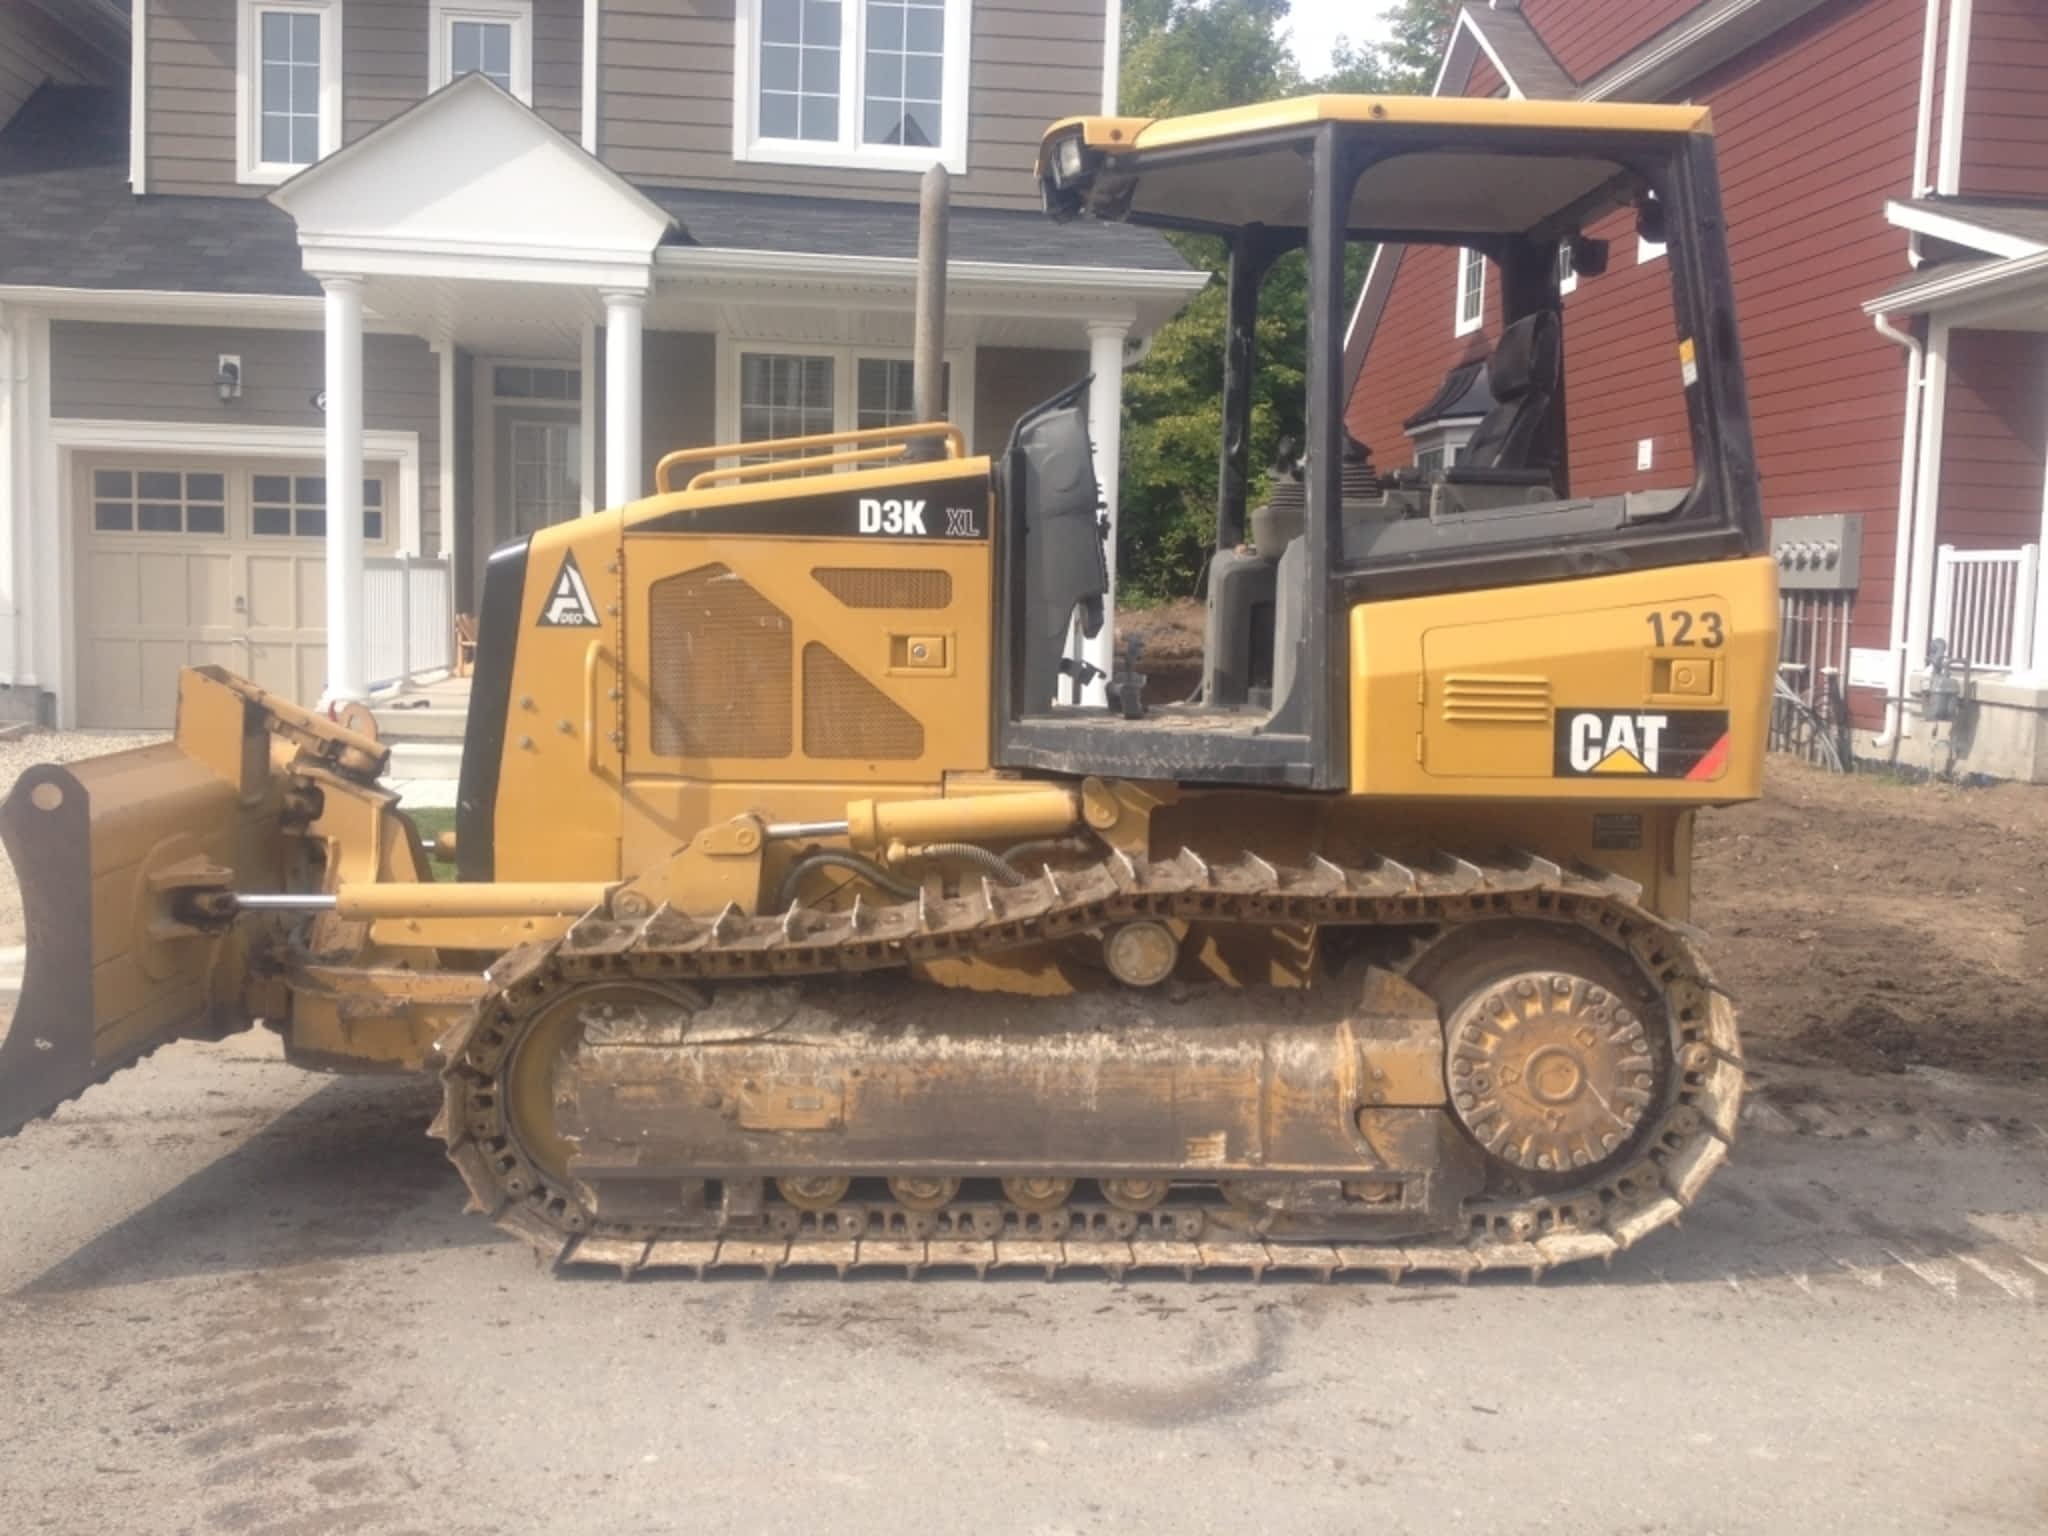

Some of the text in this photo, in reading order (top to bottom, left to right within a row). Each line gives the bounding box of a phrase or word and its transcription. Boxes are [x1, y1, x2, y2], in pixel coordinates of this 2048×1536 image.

[859, 499, 980, 537] D3K XL
[1647, 610, 1724, 648] 123
[1569, 713, 1668, 773] CAT
